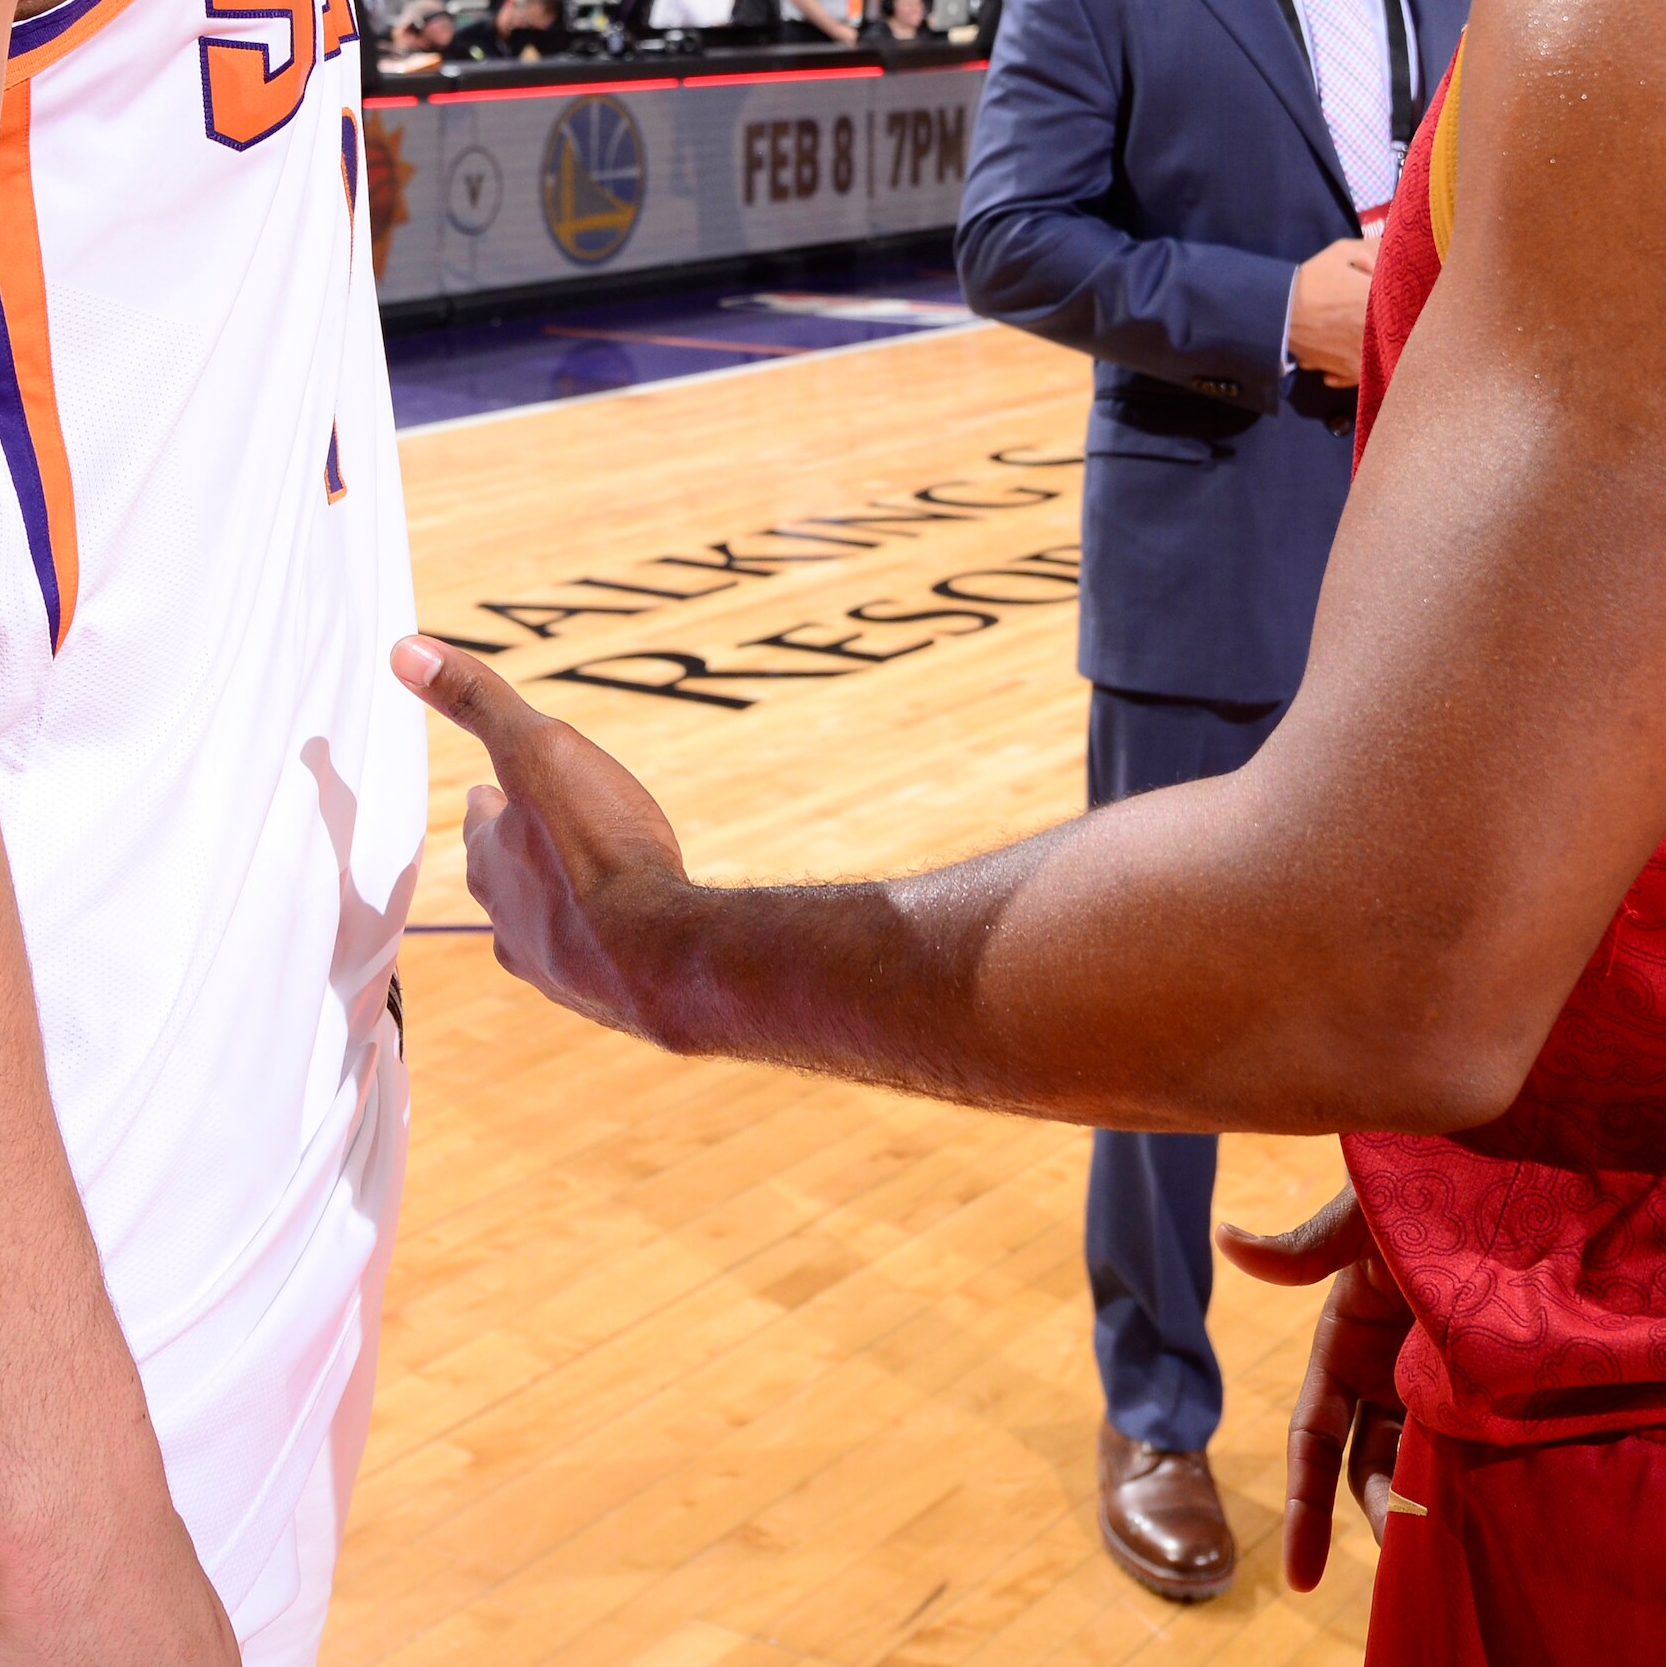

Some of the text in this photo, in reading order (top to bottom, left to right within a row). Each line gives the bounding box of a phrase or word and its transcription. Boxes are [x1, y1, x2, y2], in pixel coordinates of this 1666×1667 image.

[743, 118, 819, 207] FEB
[833, 113, 855, 198] 8
[887, 104, 968, 191] 7PM
